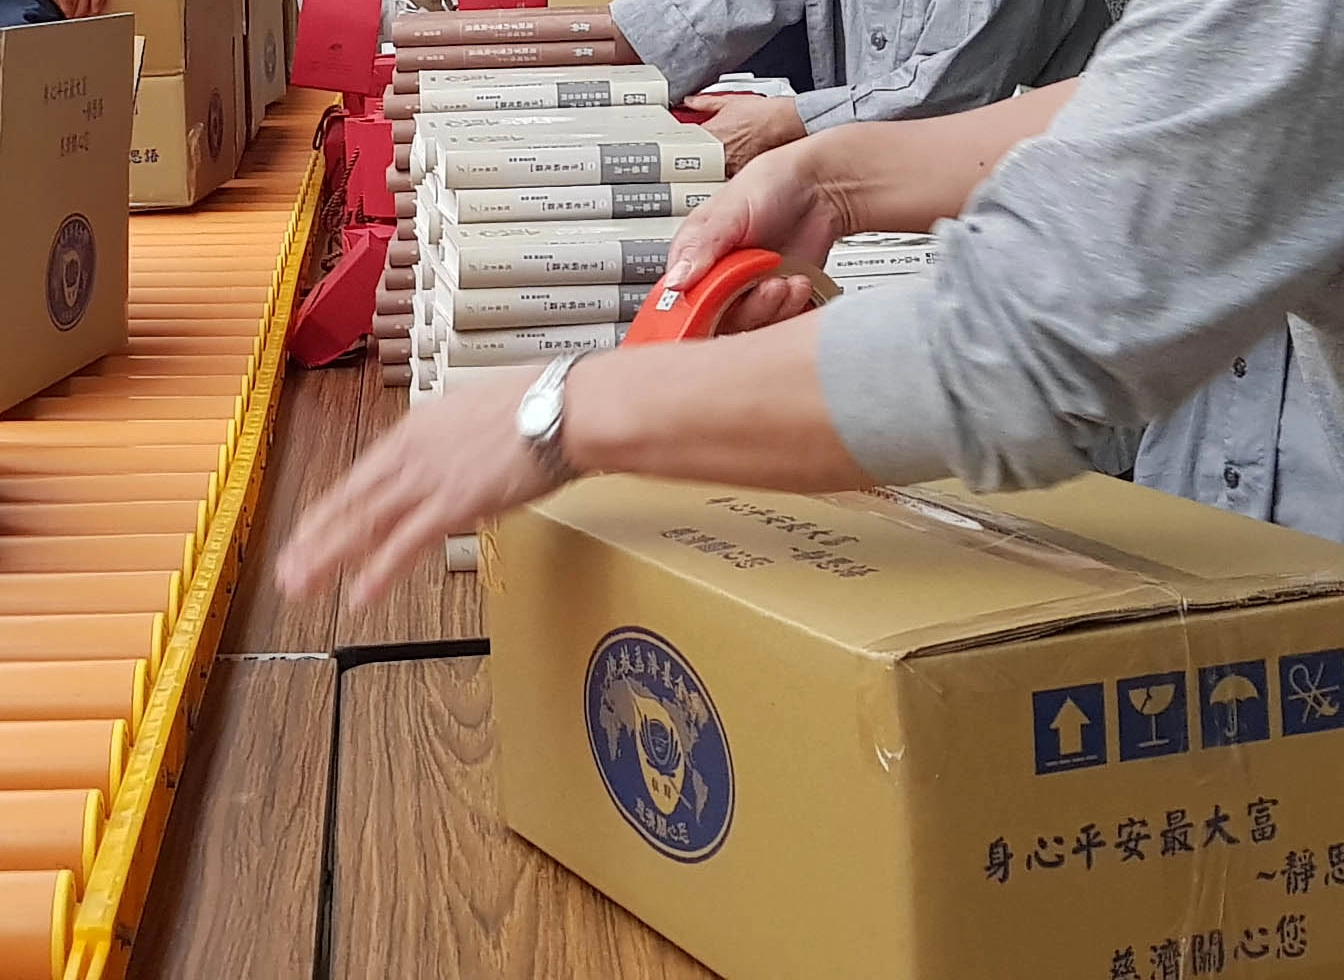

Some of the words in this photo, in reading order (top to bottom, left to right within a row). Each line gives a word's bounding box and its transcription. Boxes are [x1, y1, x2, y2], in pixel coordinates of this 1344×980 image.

[984, 796, 1280, 884] 身心平安最大富
[1110, 913, 1308, 980] 慈濟關心您
